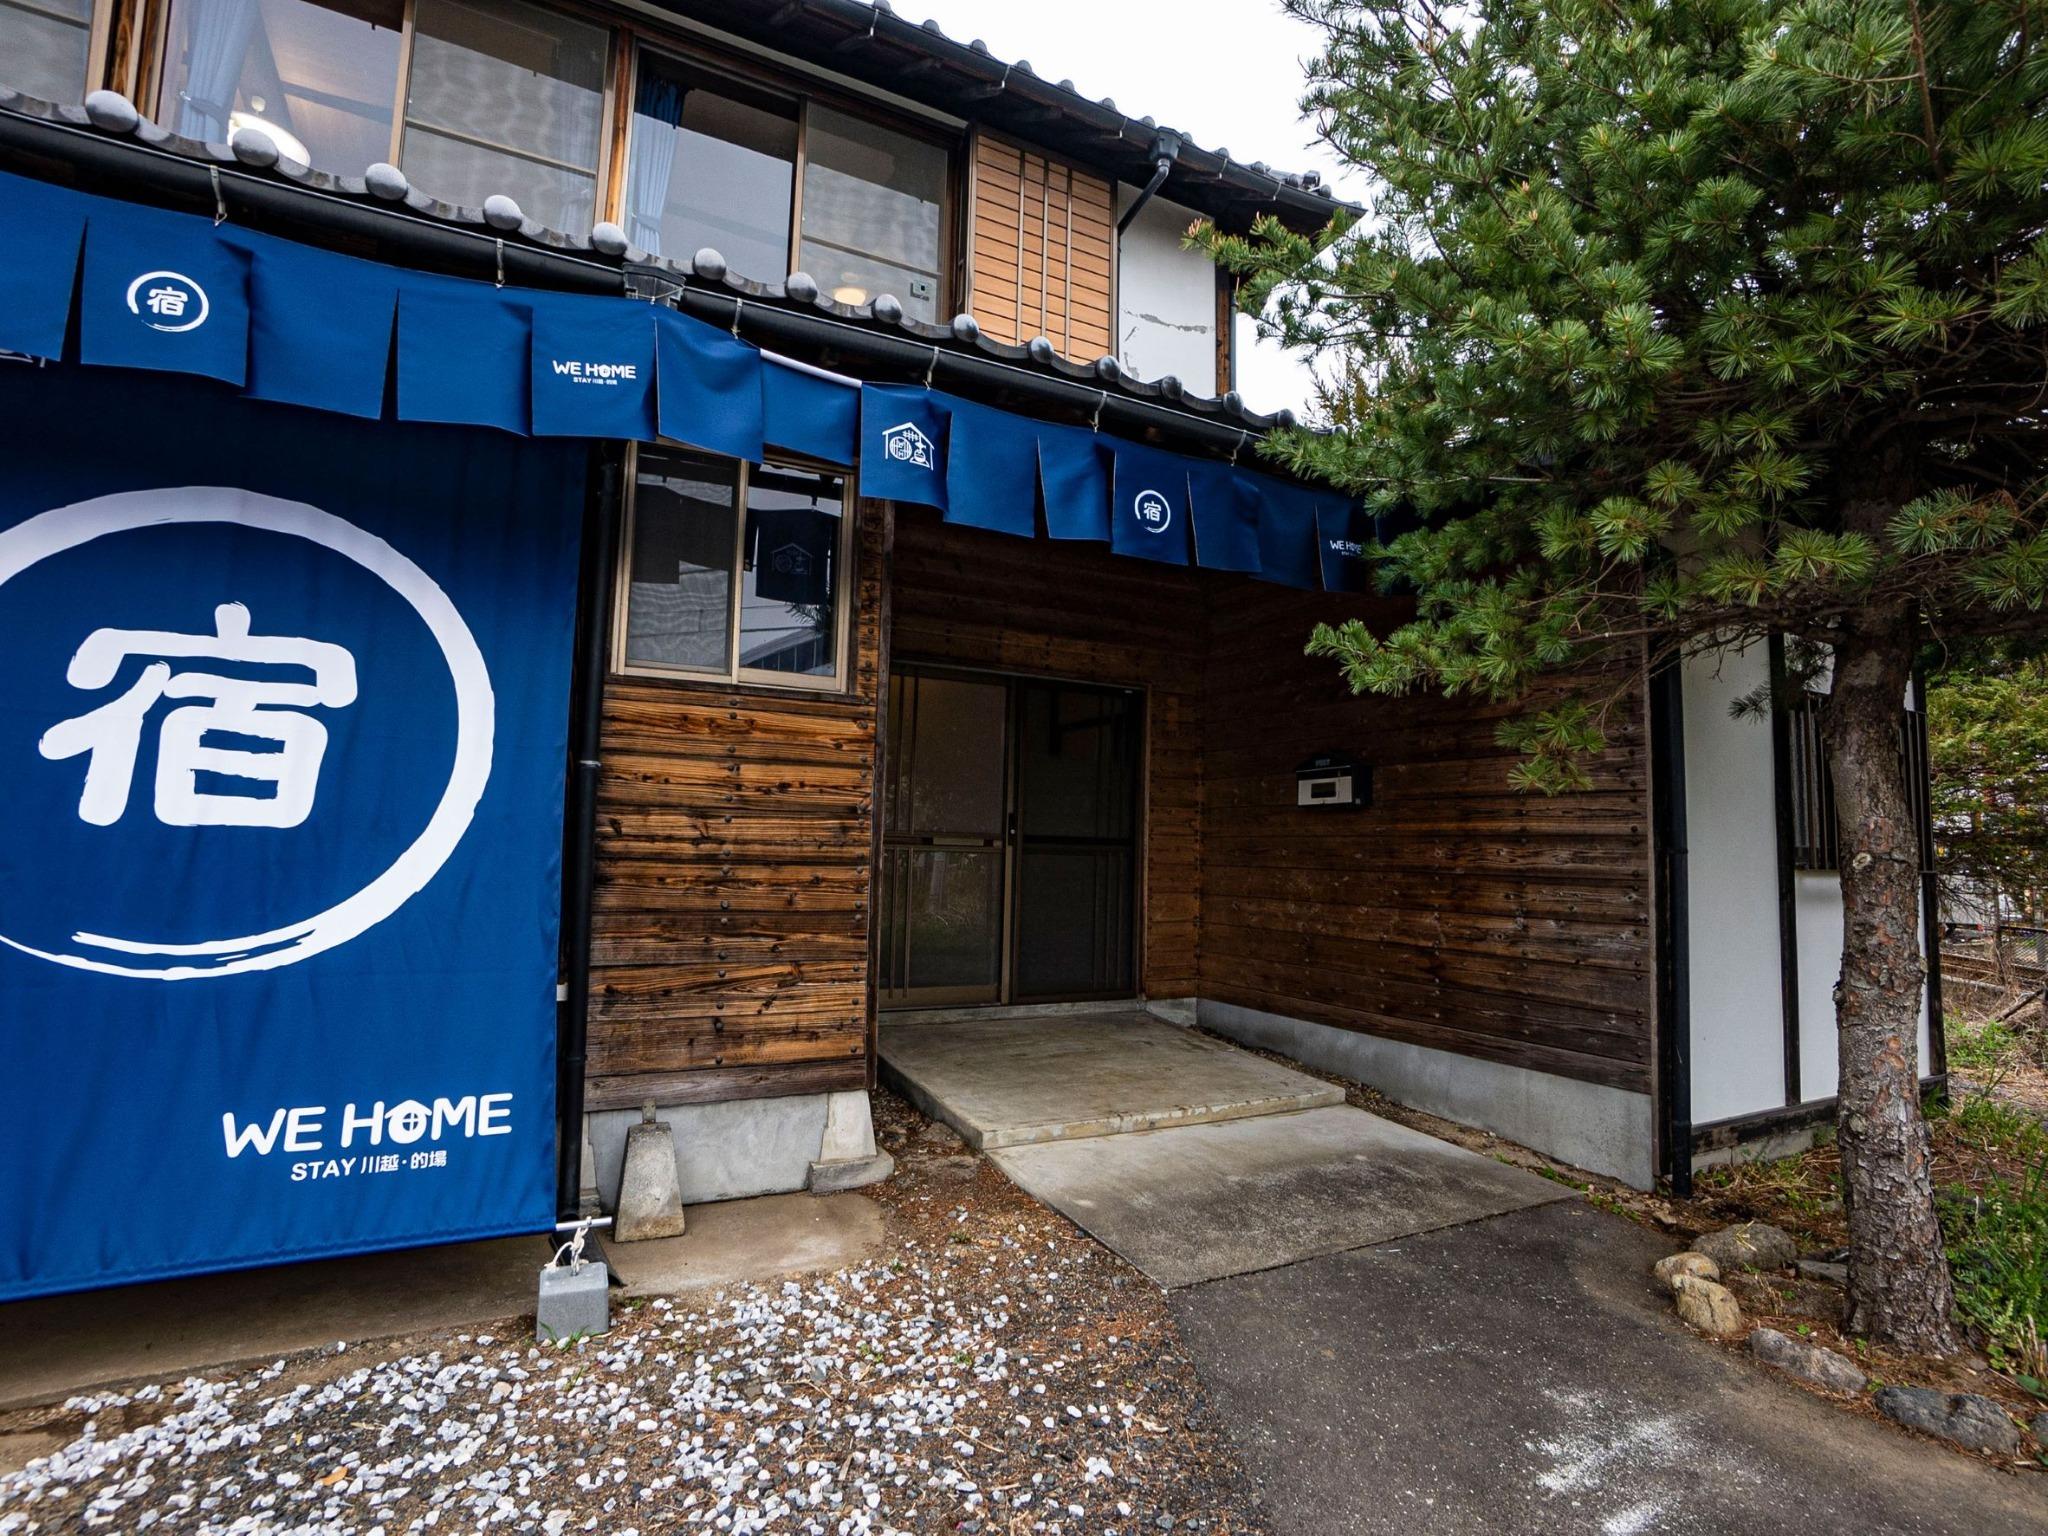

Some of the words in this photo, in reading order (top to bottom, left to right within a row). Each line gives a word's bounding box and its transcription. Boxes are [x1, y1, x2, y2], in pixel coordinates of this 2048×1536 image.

[147, 286, 188, 316] 宿
[552, 360, 581, 375] WE
[585, 363, 637, 379] HOME
[1143, 500, 1162, 522] 宿
[1329, 540, 1345, 550] WE
[38, 601, 358, 828] 宿
[222, 1105, 327, 1158] WE
[340, 1092, 514, 1148] HOME
[290, 1157, 357, 1182] STAY
